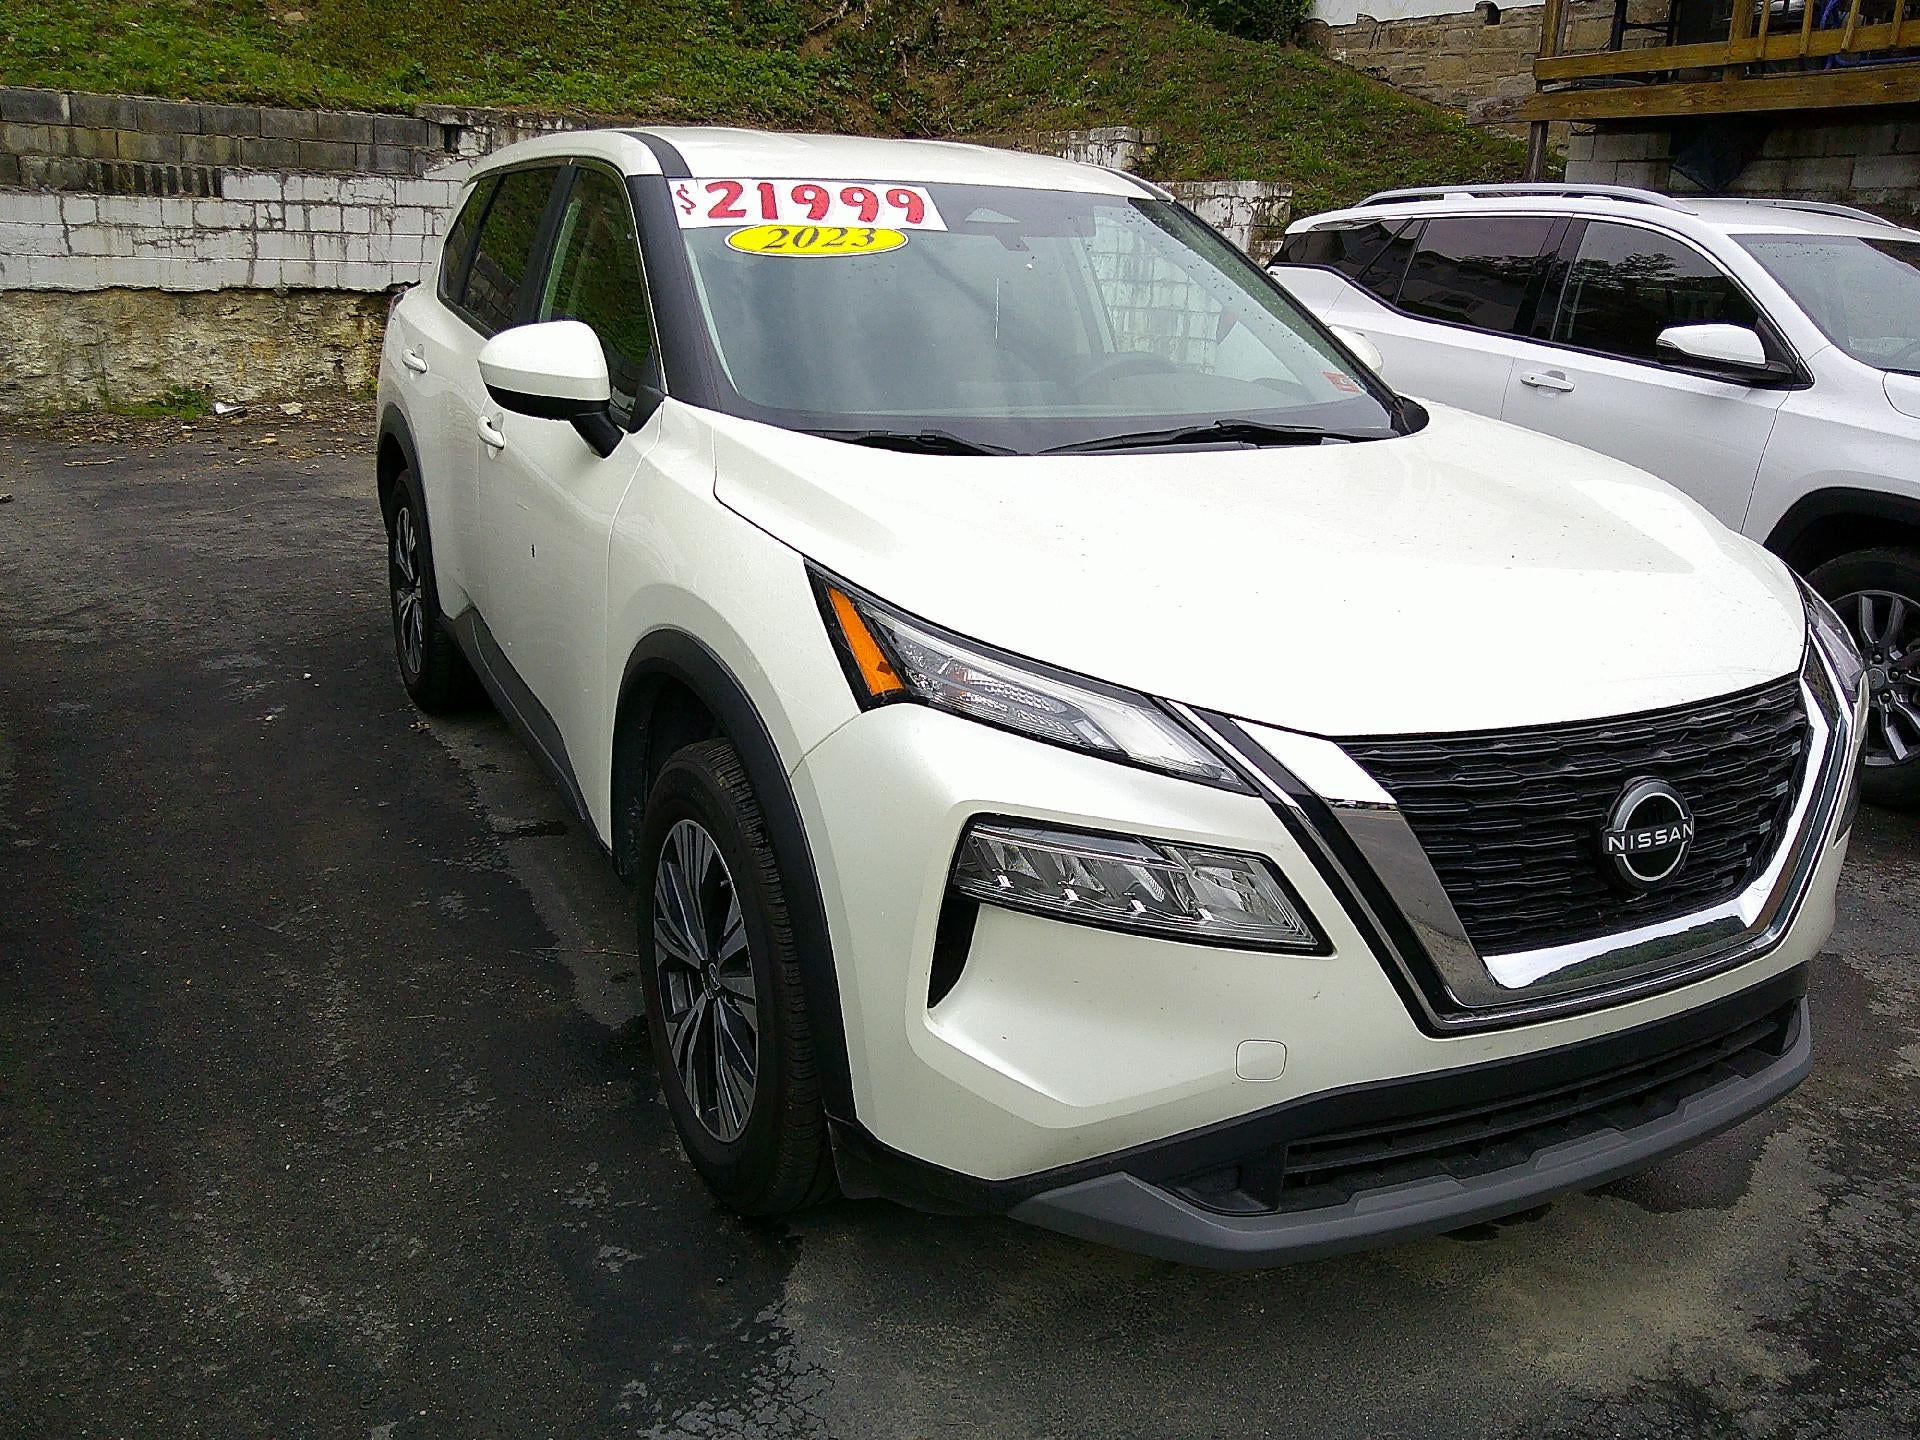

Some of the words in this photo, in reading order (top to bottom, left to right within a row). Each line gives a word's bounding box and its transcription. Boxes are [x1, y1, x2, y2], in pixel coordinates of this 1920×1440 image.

[676, 181, 925, 224] $21999
[762, 227, 876, 249] 2023
[1608, 822, 1693, 852] NISSAN
